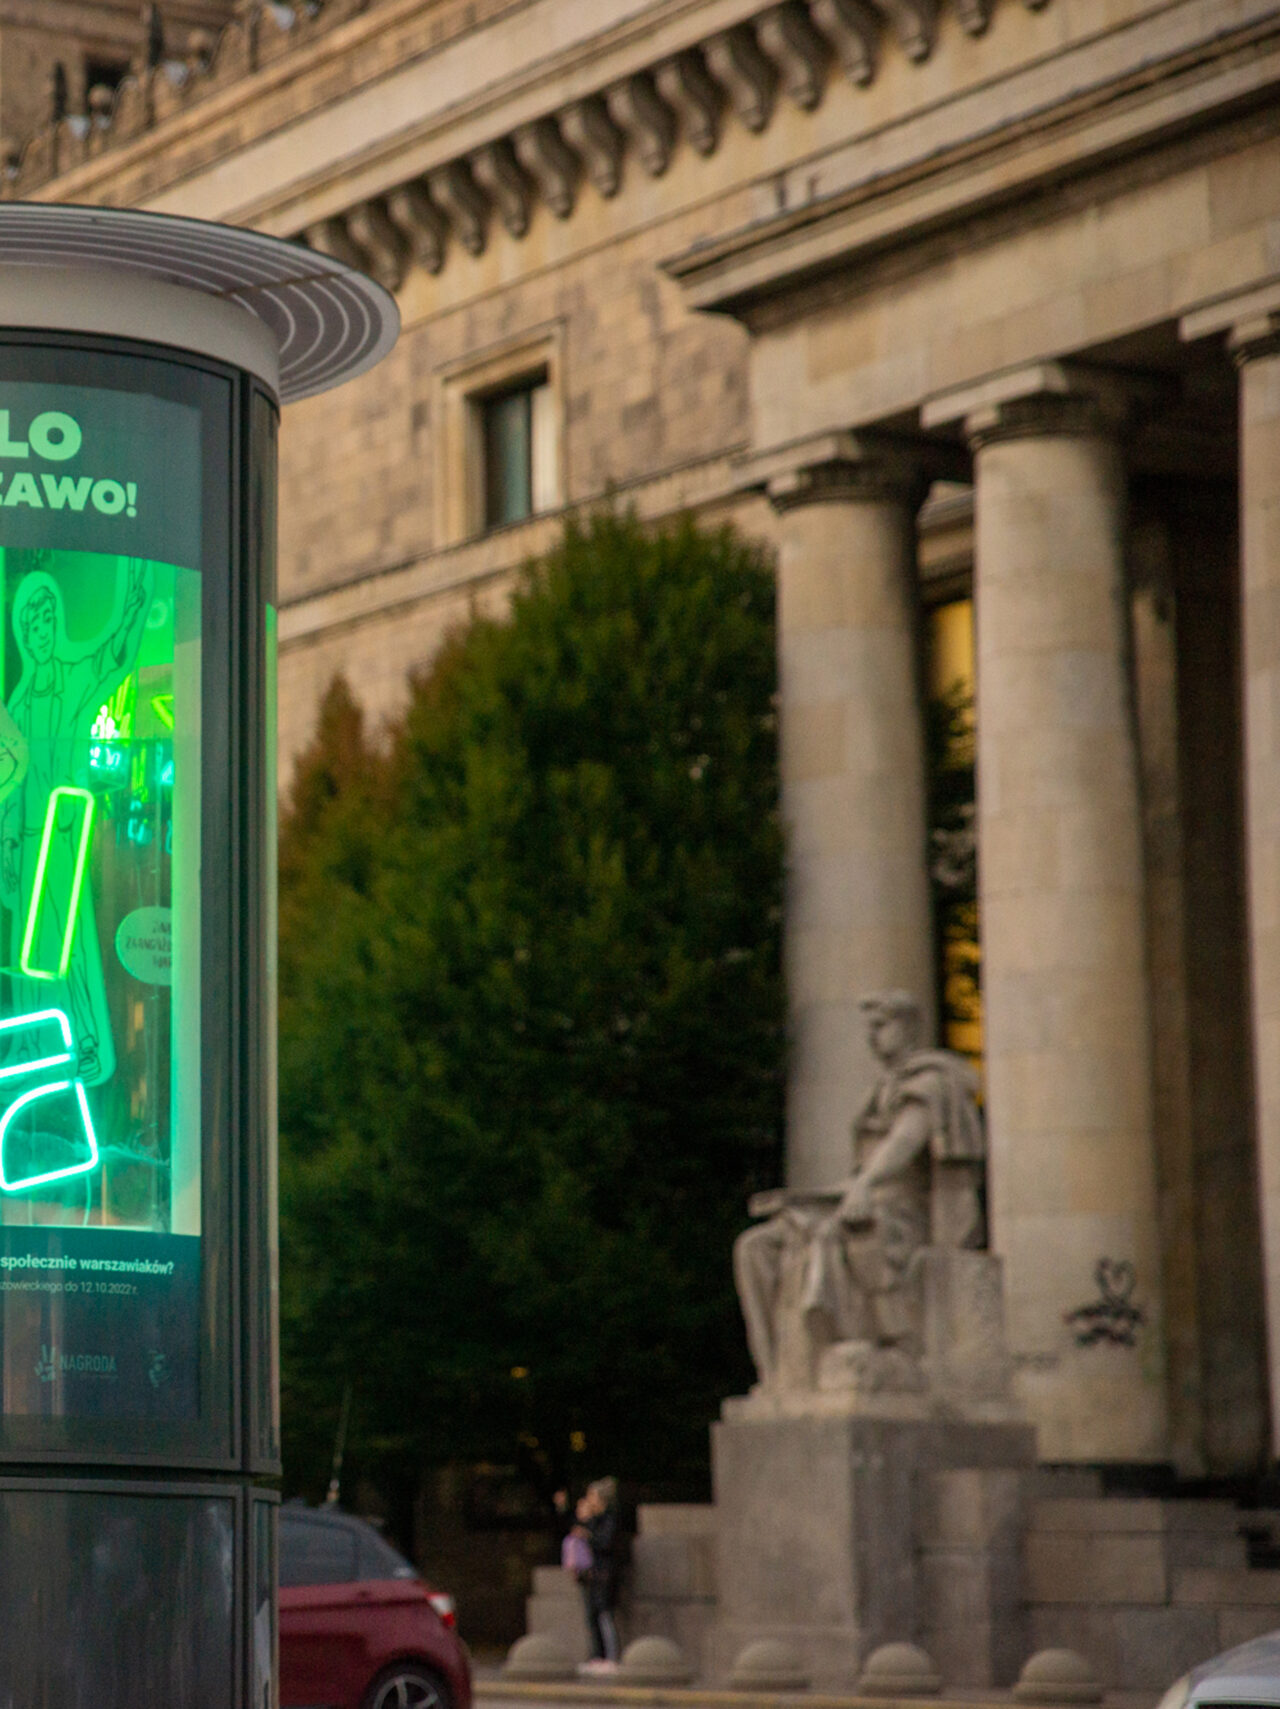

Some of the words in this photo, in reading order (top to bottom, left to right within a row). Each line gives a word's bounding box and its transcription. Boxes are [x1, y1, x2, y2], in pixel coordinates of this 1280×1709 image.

[0, 1253, 78, 1271] społecznie
[79, 1258, 175, 1276] warszawiaków?
[64, 1281, 79, 1292] do
[59, 1354, 118, 1372] NAGRODA
